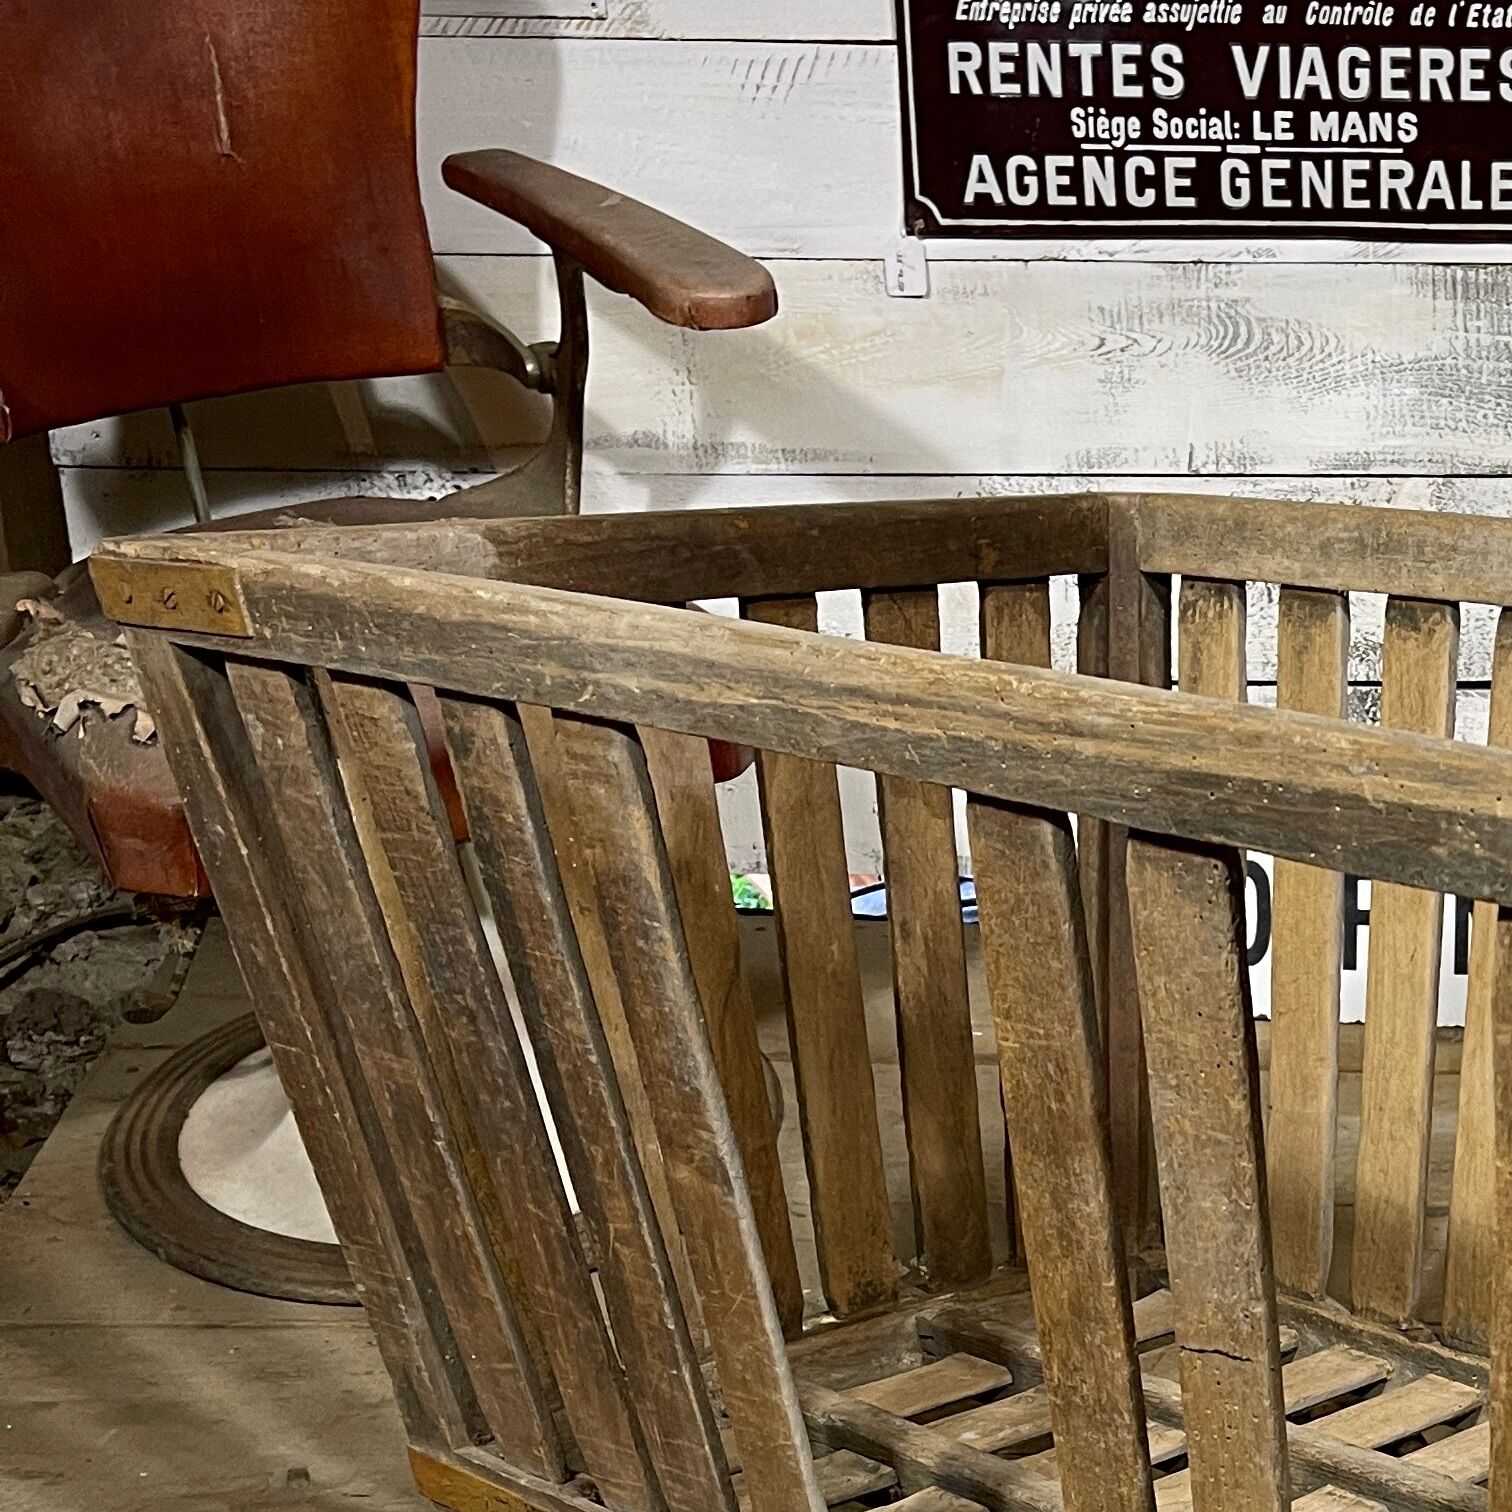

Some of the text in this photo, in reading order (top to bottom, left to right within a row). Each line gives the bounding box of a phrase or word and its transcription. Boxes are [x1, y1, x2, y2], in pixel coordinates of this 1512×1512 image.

[955, 0, 1061, 29] Entreprise
[1142, 0, 1243, 31] assujettie
[1262, 4, 1288, 24] au
[1305, 1, 1394, 27] Contrôle
[1409, 2, 1436, 27] de
[947, 41, 1185, 99] RENTES
[1070, 106, 1418, 147] Siège Social: LE MANS
[963, 153, 1198, 207] AGENCE
